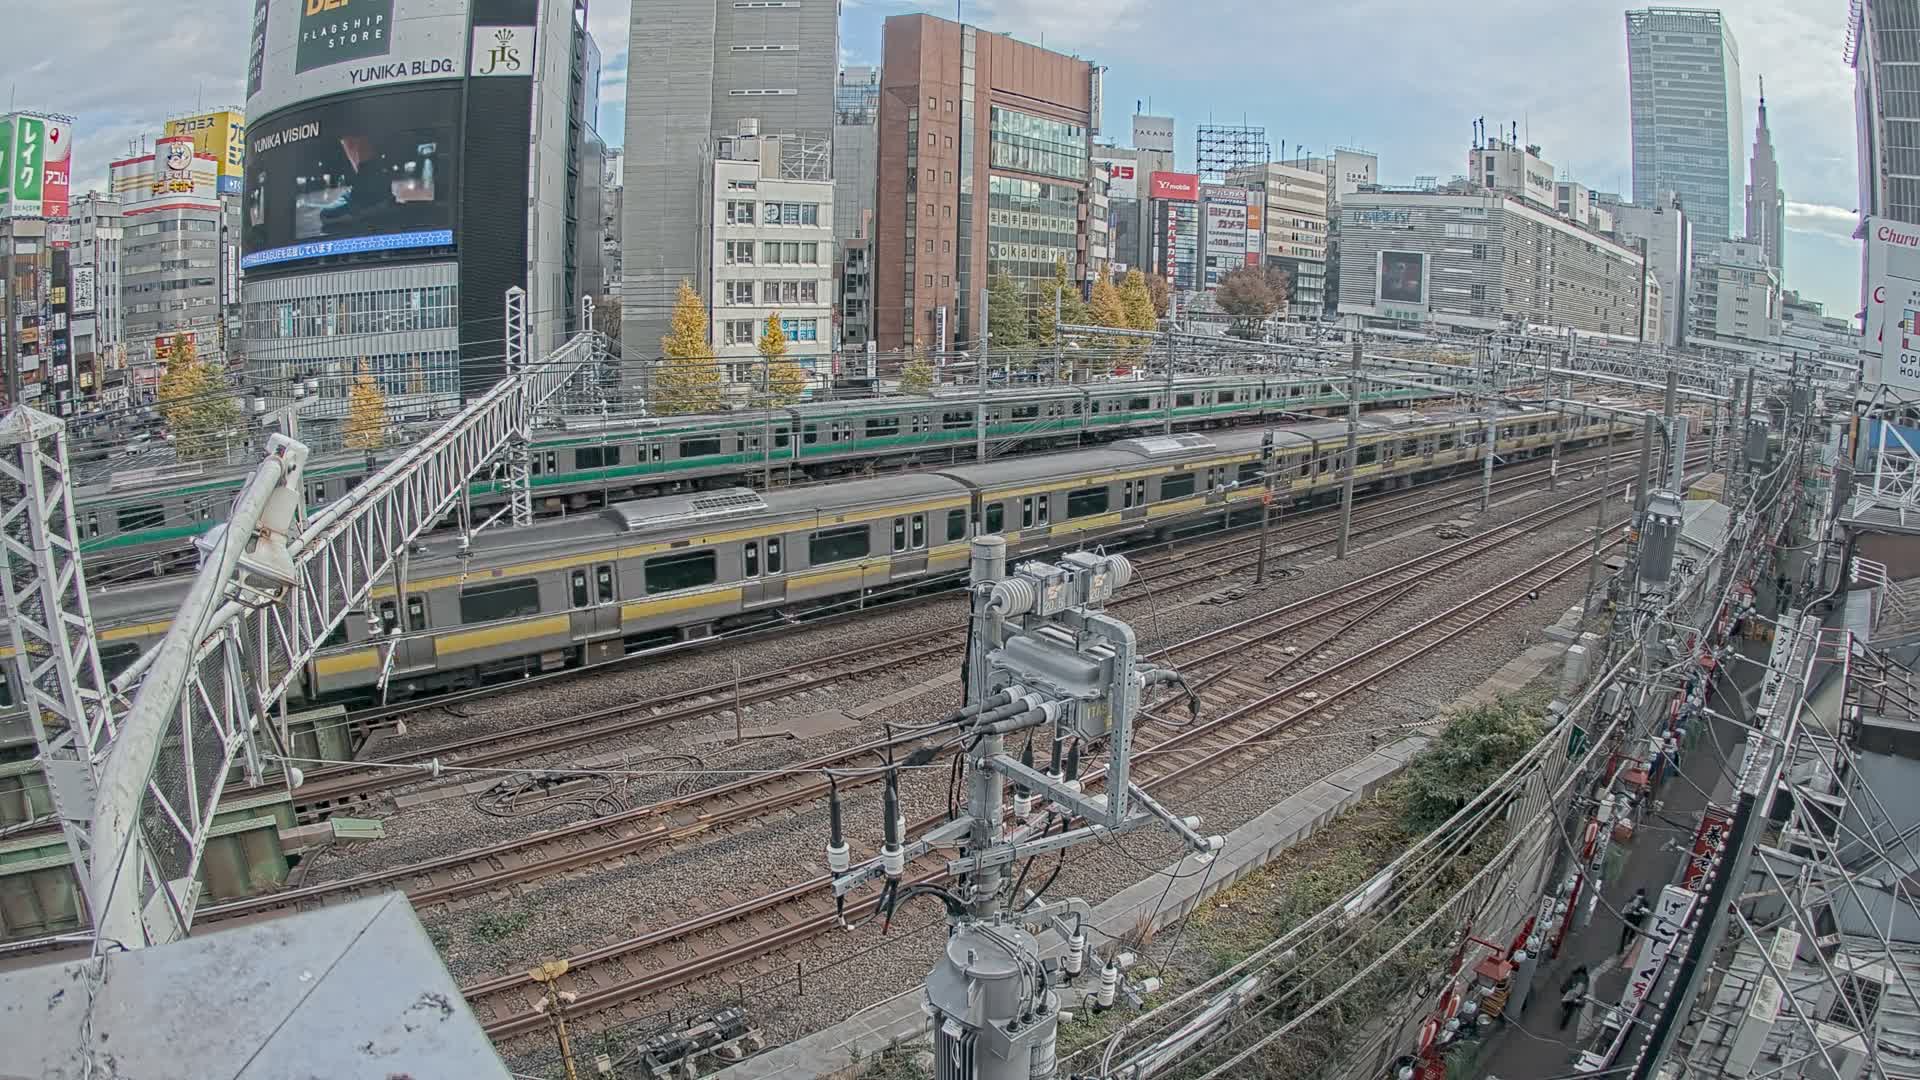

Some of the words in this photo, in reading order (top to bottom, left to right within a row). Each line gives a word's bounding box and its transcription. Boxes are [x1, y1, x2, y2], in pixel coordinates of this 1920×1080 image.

[303, 15, 383, 42] FLAGSHIP
[328, 29, 383, 48] STORE
[350, 63, 408, 84] YUNIKA
[411, 59, 456, 76] BLDG.
[175, 117, 216, 132] プロミス
[254, 131, 283, 153] YUNIKA
[282, 121, 319, 145] VISION
[20, 121, 37, 190] レイク
[45, 170, 67, 186] アコム
[990, 213, 1075, 231] 生地手芸材料専門店
[1878, 226, 1918, 247] Churu
[1000, 247, 1066, 262] okadaya
